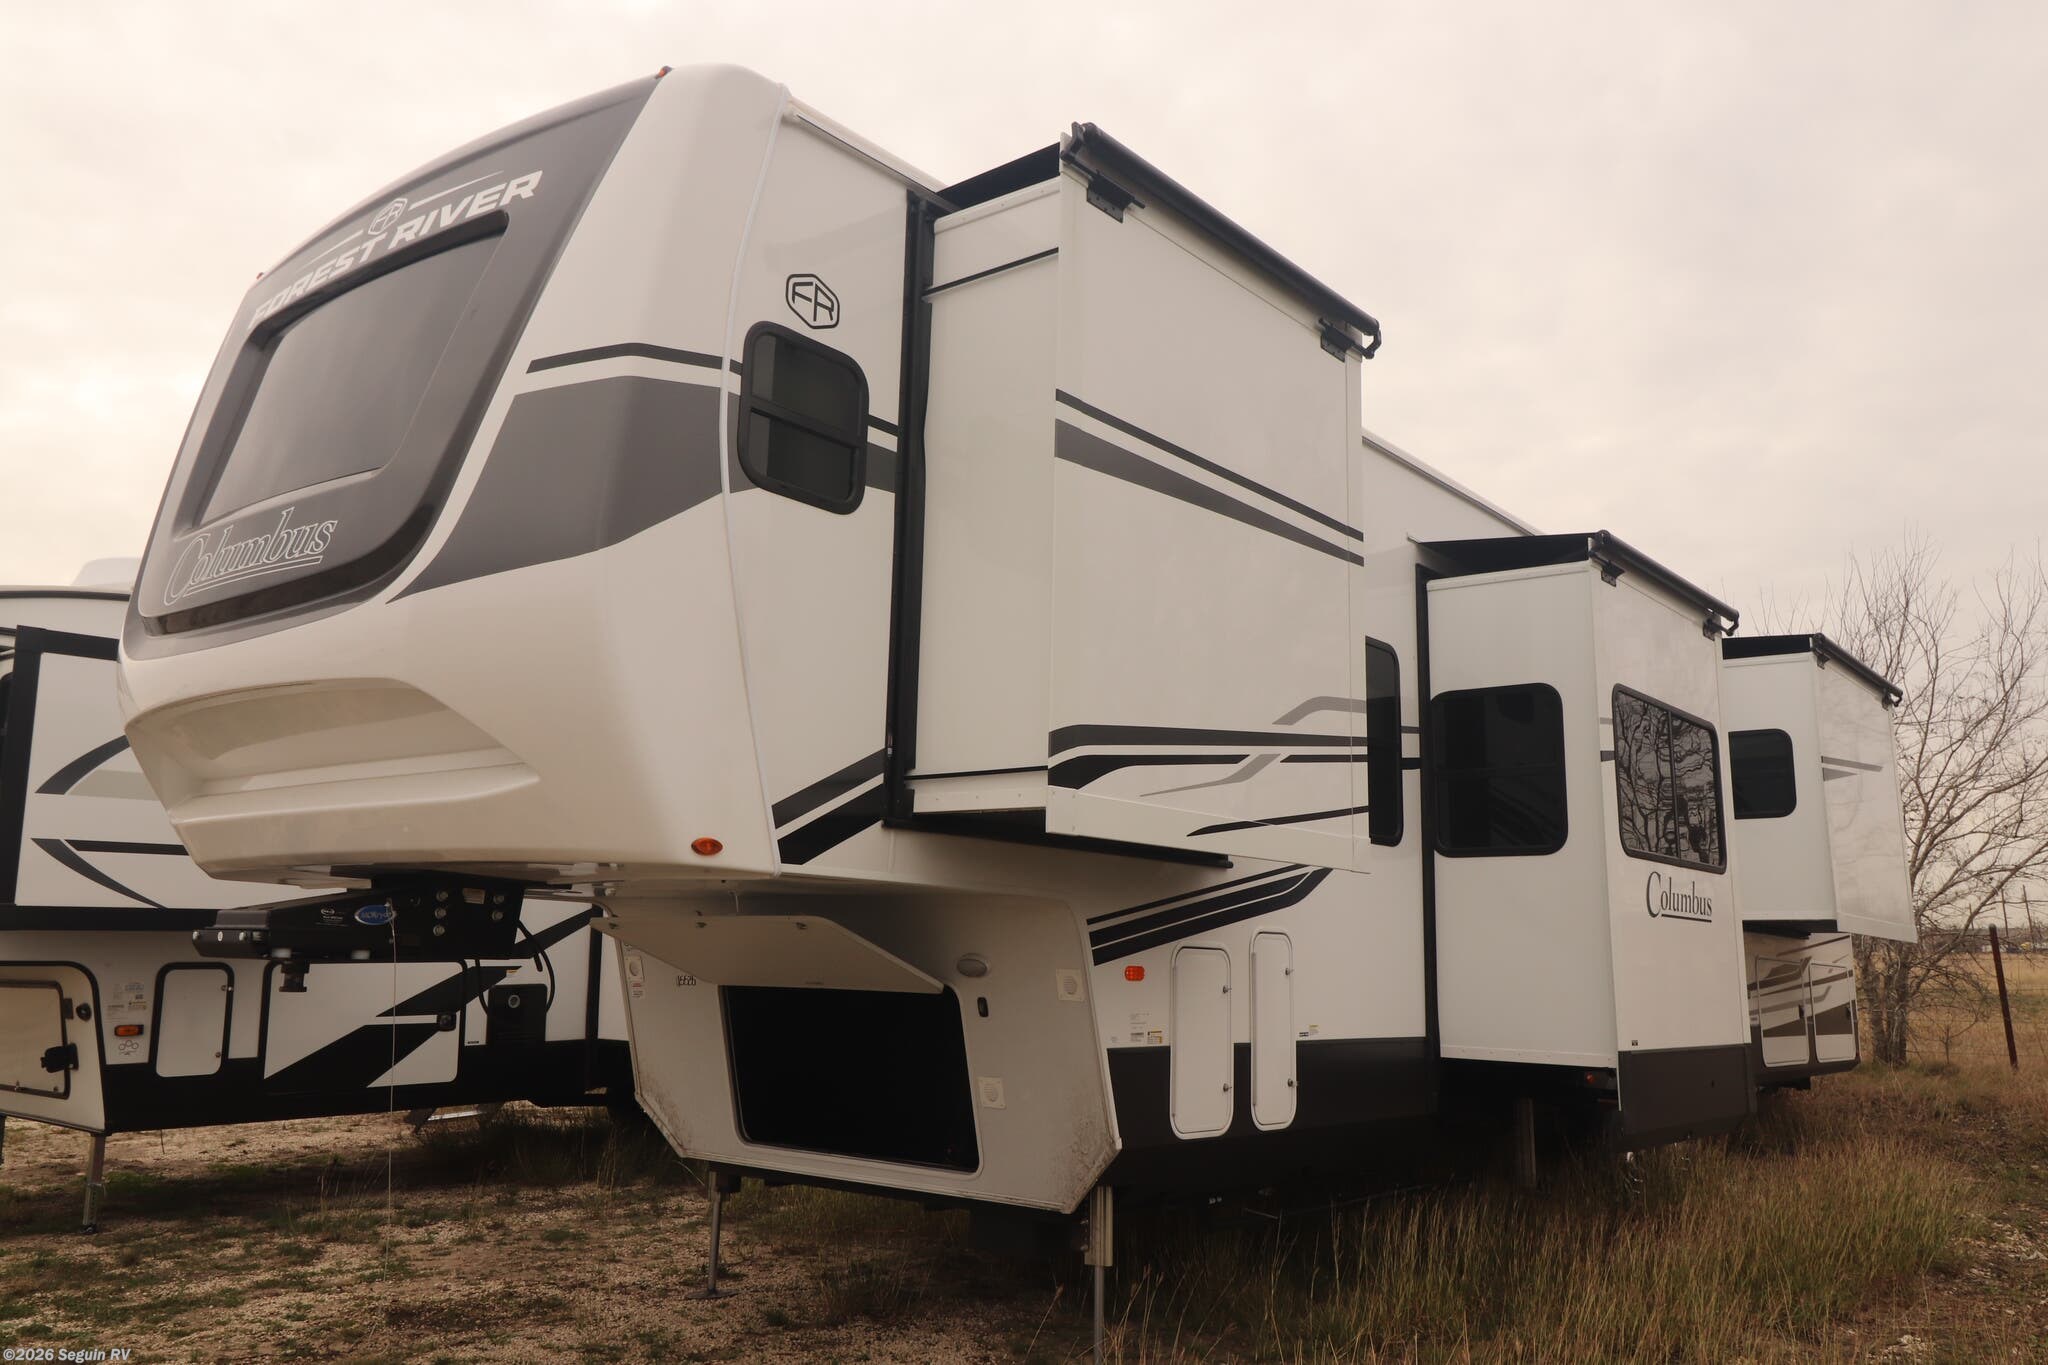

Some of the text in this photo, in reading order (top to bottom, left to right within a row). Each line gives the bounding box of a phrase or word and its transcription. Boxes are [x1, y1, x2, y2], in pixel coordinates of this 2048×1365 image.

[248, 170, 543, 329] FOREST RIVER
[791, 281, 835, 322] FR
[163, 506, 338, 606] Columbus
[1646, 871, 1713, 918] Columbus
